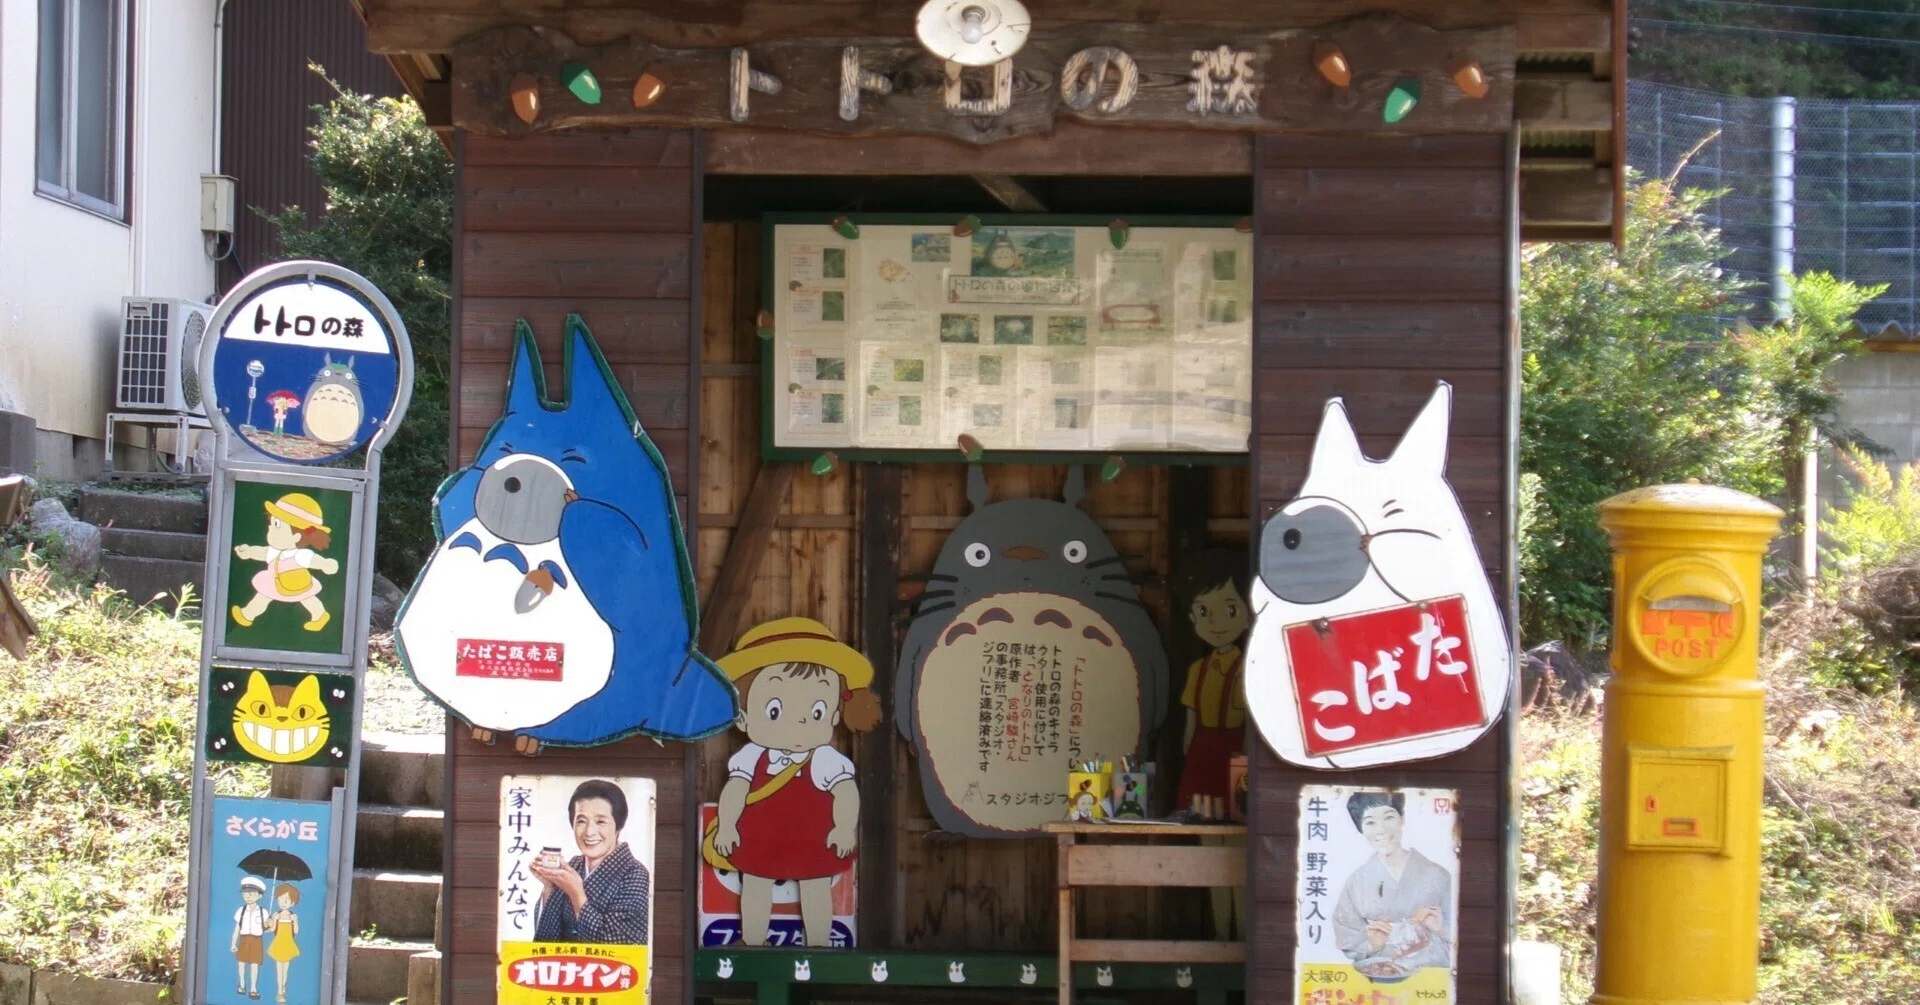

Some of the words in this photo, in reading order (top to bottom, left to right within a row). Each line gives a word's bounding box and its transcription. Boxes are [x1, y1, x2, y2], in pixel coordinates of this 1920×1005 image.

[730, 45, 1258, 122] トトロの森
[254, 304, 364, 338] トトロの森
[1310, 612, 1468, 742] たばこ
[1655, 639, 1720, 659] POST
[1068, 657, 1086, 773] 「トトロの森」につい
[225, 815, 318, 841] さくらが丘
[1307, 796, 1329, 841] 牛肉
[506, 786, 531, 930] 家中みんなで
[1305, 852, 1329, 944] 野菜入り
[514, 961, 621, 988] オロナイン
